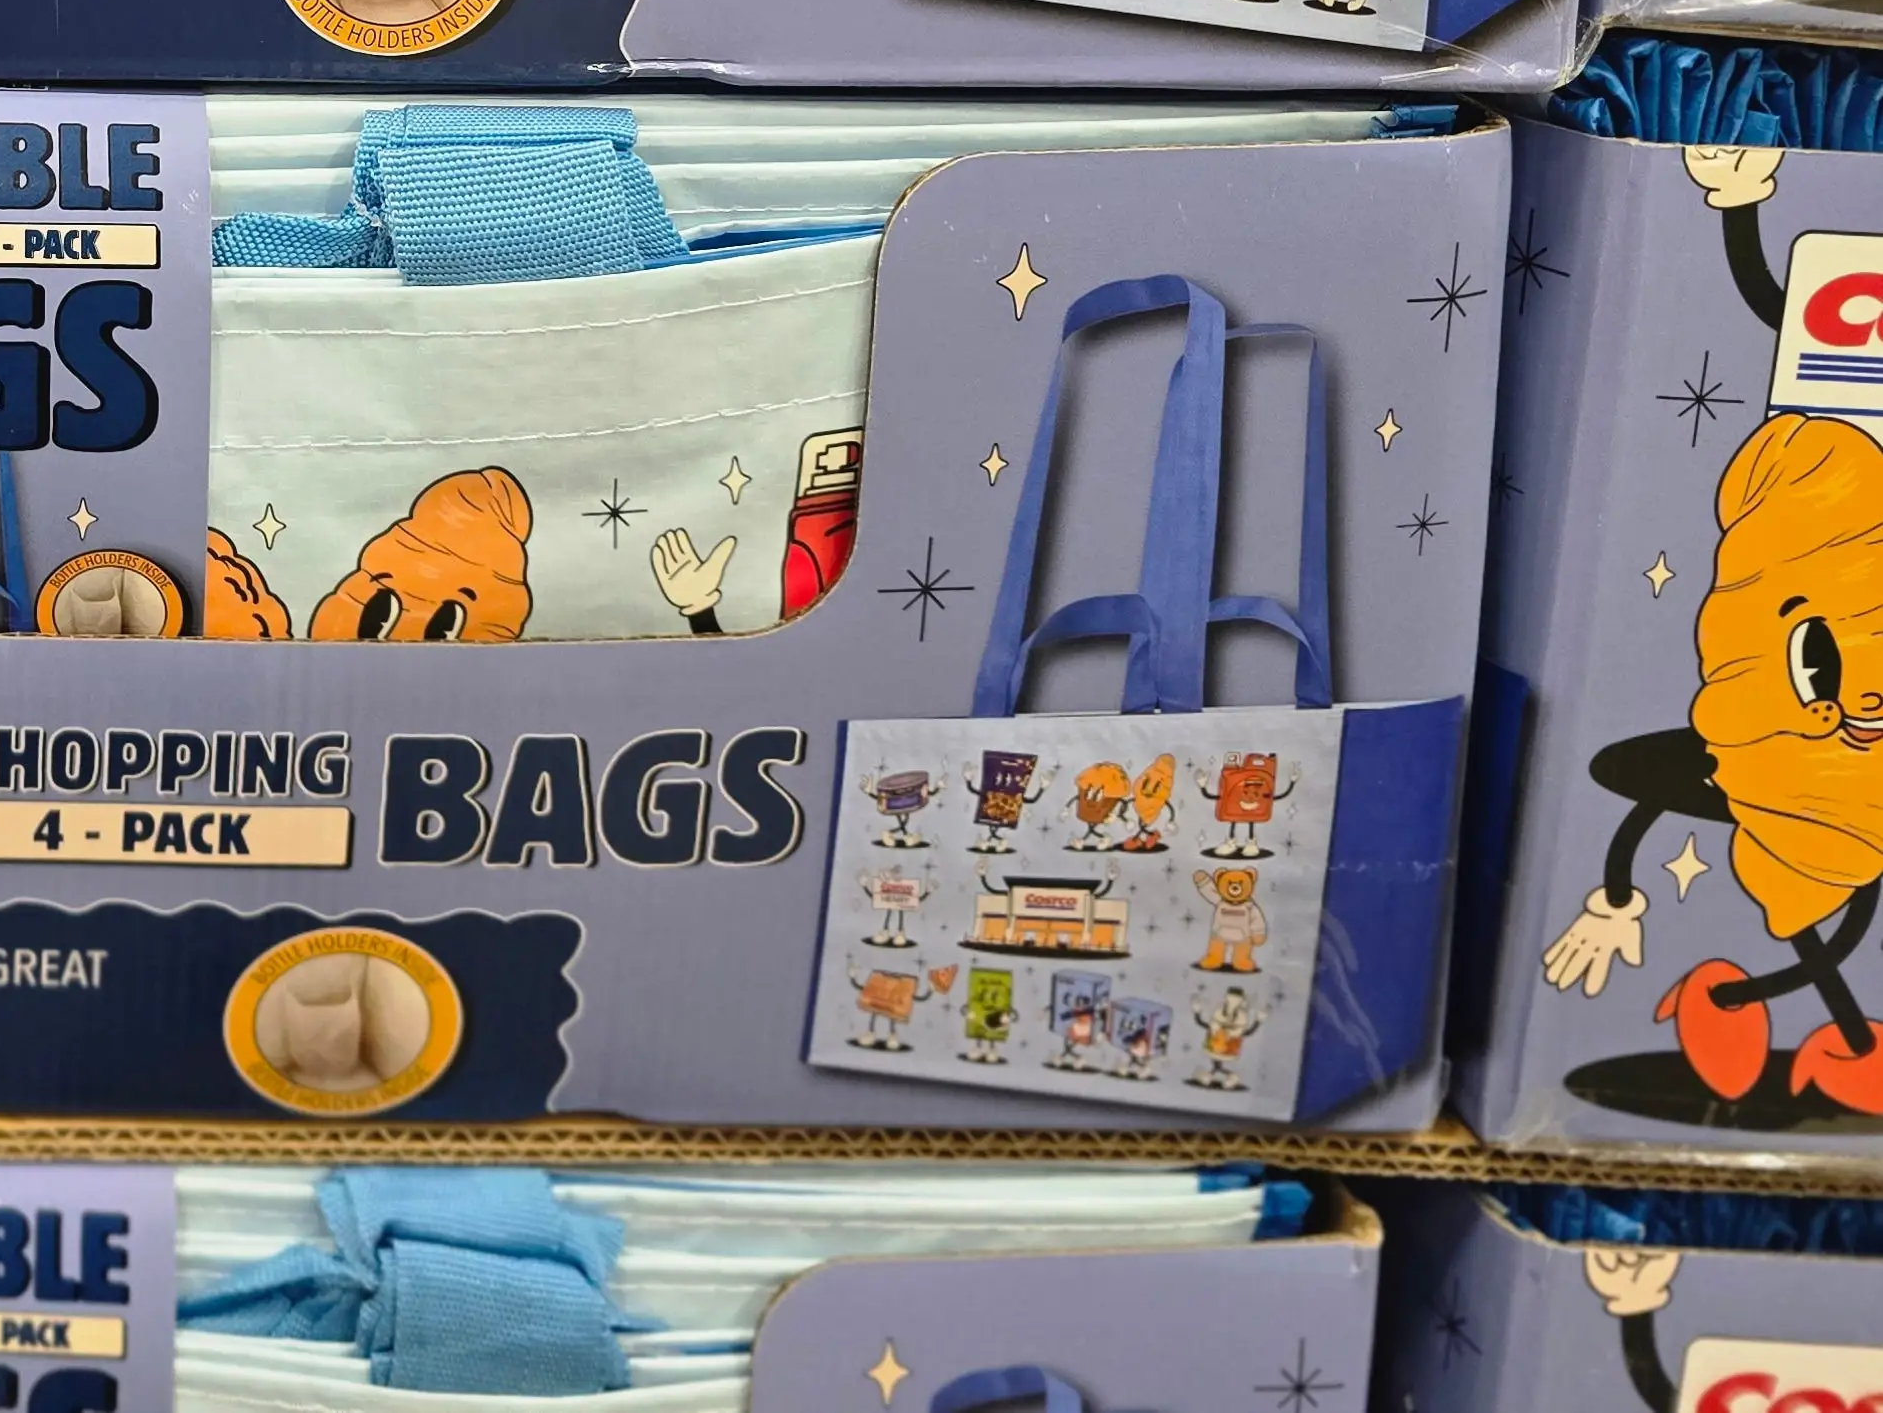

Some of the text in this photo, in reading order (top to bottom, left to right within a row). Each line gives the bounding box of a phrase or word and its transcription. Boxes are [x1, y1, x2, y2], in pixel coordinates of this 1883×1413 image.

[347, 24, 435, 49] HOLDERS
[2, 244, 14, 252] -
[24, 228, 103, 260] PACK
[50, 553, 173, 590] BOTTLE HOLDERS INSIDE
[377, 725, 806, 869] BAGS
[32, 810, 251, 856] 4 - PACK
[249, 933, 390, 985] BOTTLE HOLDERS
[0, 1321, 70, 1349] PACK
